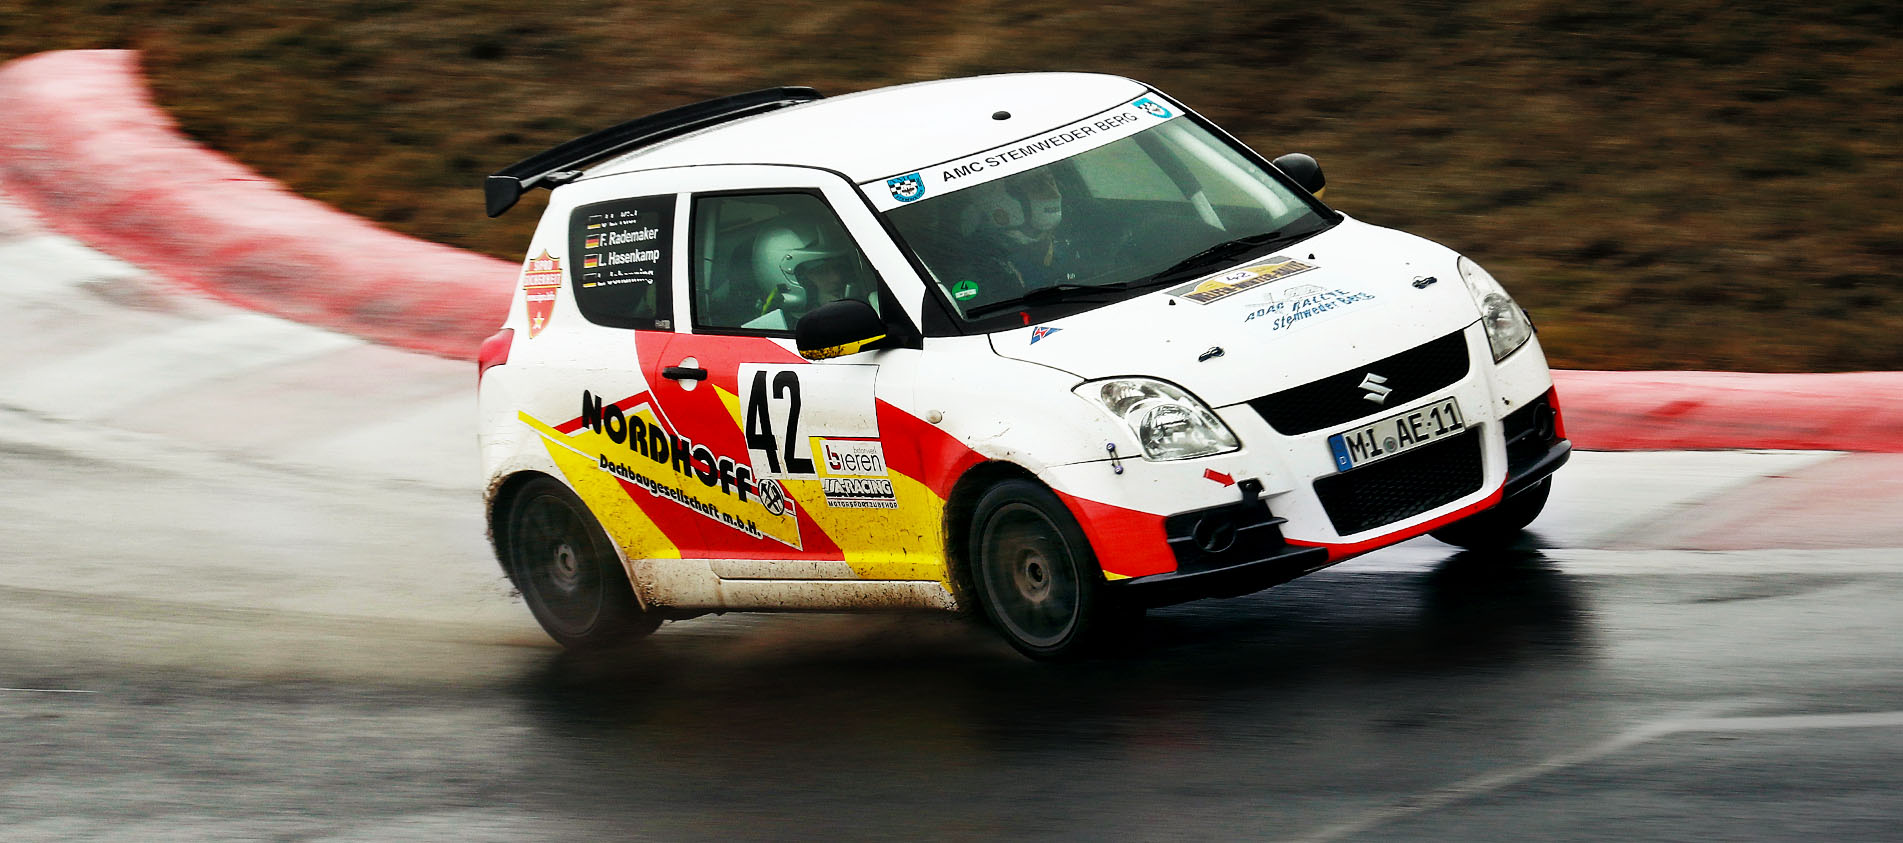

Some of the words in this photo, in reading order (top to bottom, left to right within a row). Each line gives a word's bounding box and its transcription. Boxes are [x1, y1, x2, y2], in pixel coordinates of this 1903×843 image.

[942, 161, 985, 182] AMC
[985, 126, 1097, 168] STEMWEDER
[1093, 111, 1139, 132] BERG
[600, 233, 608, 247] F.
[609, 226, 659, 246] Rademaker
[598, 252, 607, 267] L.
[608, 248, 660, 264] Hasenkamp
[960, 280, 969, 290] 4
[1272, 301, 1338, 331] Stemweder
[745, 370, 816, 474] 42
[582, 389, 753, 503] NORDHOFF
[825, 444, 883, 472] bieren
[600, 453, 720, 519] Dachbaugesellschaft
[722, 511, 762, 538] m.b.H.
